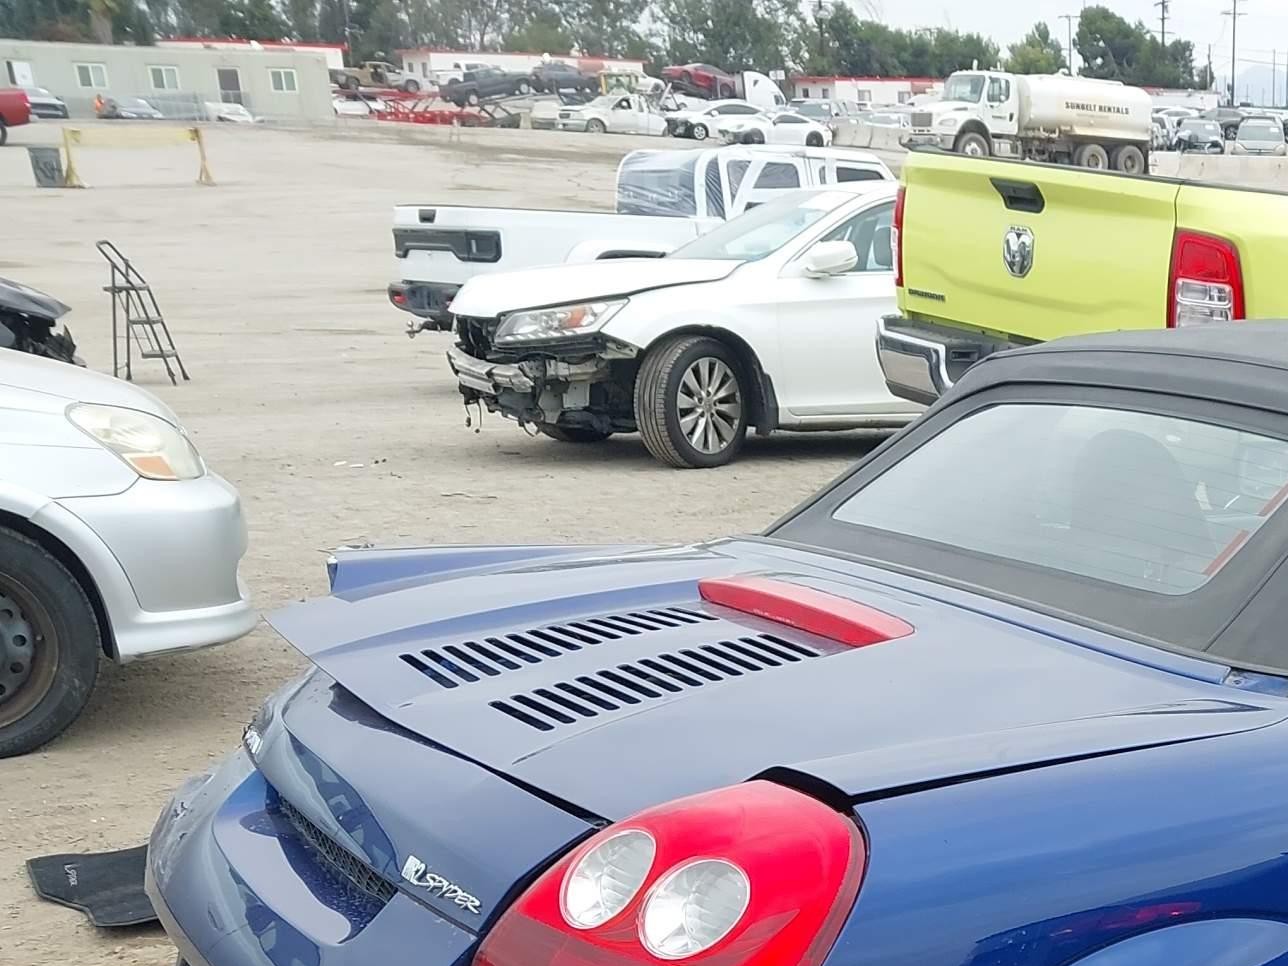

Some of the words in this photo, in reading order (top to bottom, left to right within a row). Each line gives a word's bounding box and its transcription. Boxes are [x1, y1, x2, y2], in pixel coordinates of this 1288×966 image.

[1065, 101, 1096, 112] SUNBELT
[1098, 104, 1130, 115] RENTALS
[425, 873, 480, 914] SPYDER
